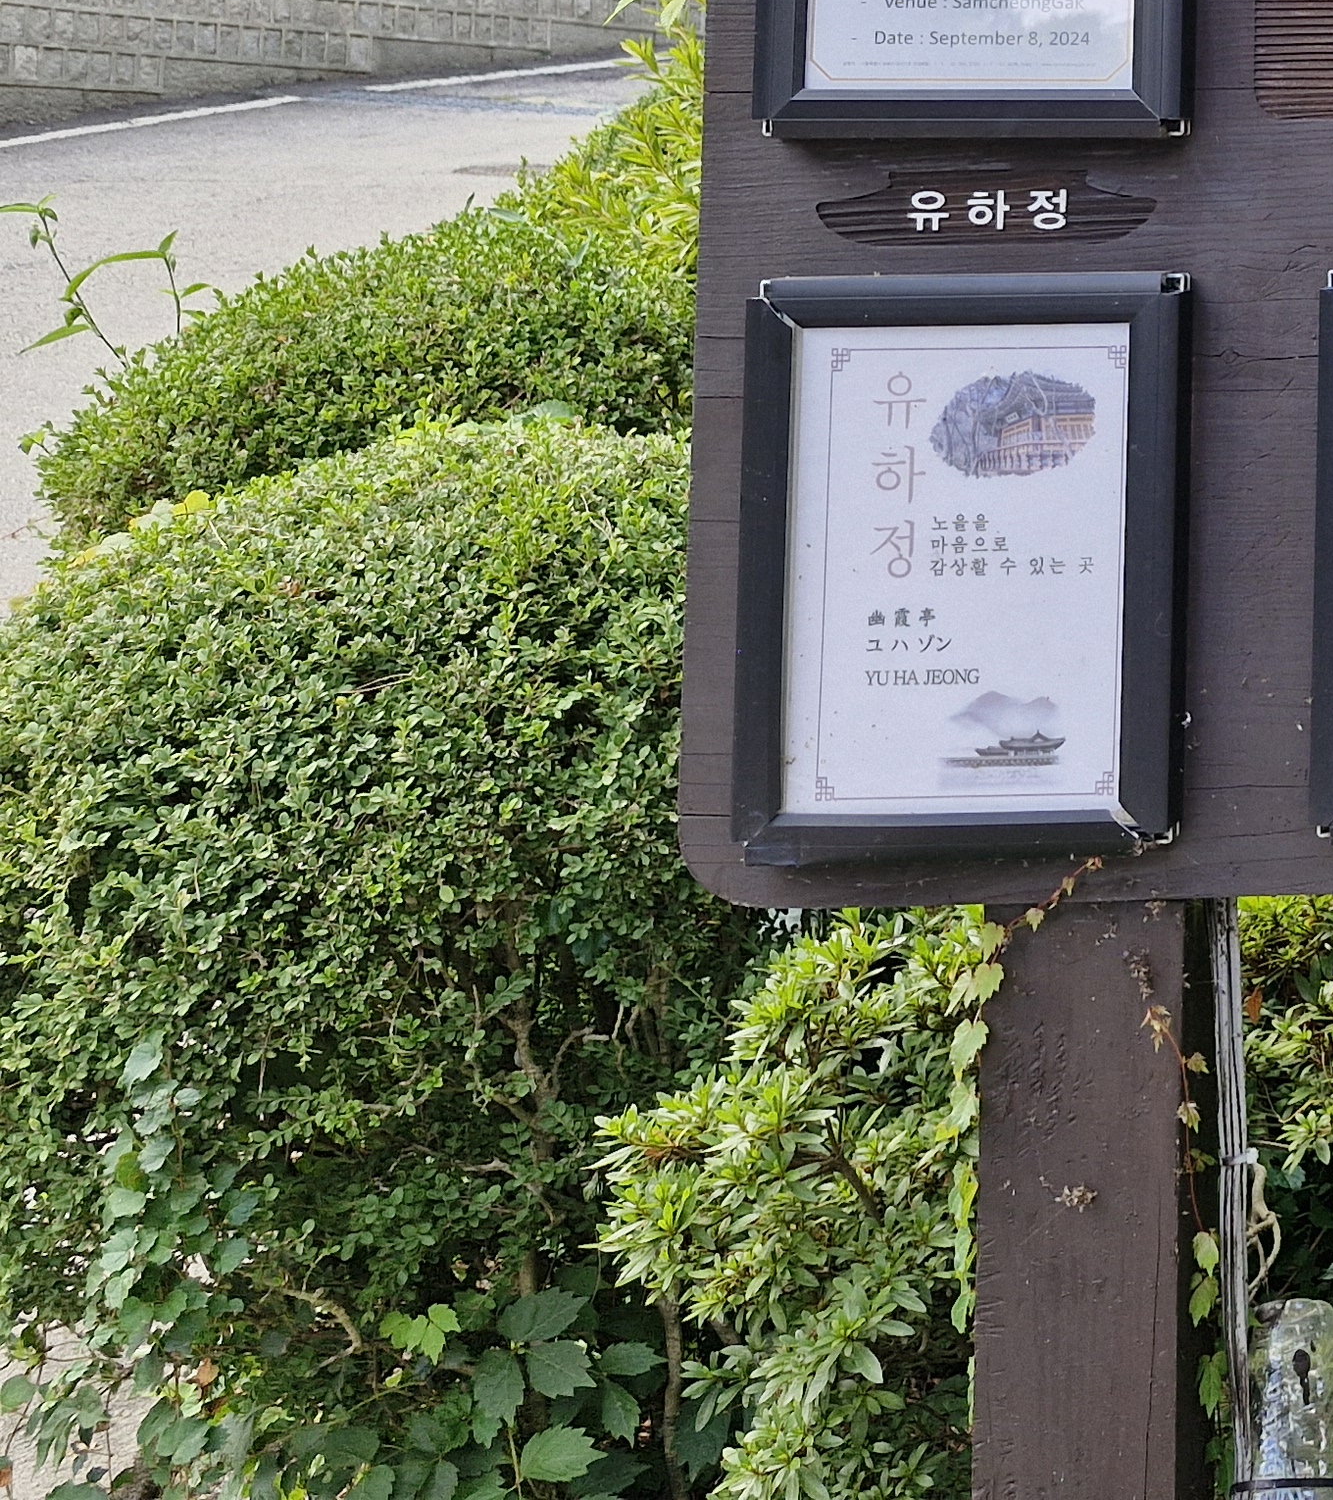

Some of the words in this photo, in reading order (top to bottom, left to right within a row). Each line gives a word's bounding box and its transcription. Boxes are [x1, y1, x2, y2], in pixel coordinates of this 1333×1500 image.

[875, 31, 913, 44] Date
[930, 31, 1023, 48] September
[1028, 31, 1042, 47] 8,
[1049, 31, 1089, 45] 2024
[907, 189, 1066, 230] 유하정
[871, 371, 927, 578] 유하정
[932, 513, 989, 532] 노을을
[931, 536, 1008, 554] 마음으로
[930, 557, 988, 576] 감상할
[1000, 557, 1016, 575] 수
[1029, 556, 1065, 575] 있는
[1079, 557, 1094, 574] 곳
[865, 671, 889, 686] YU
[894, 670, 919, 685] HA
[923, 668, 979, 685] JEONG
